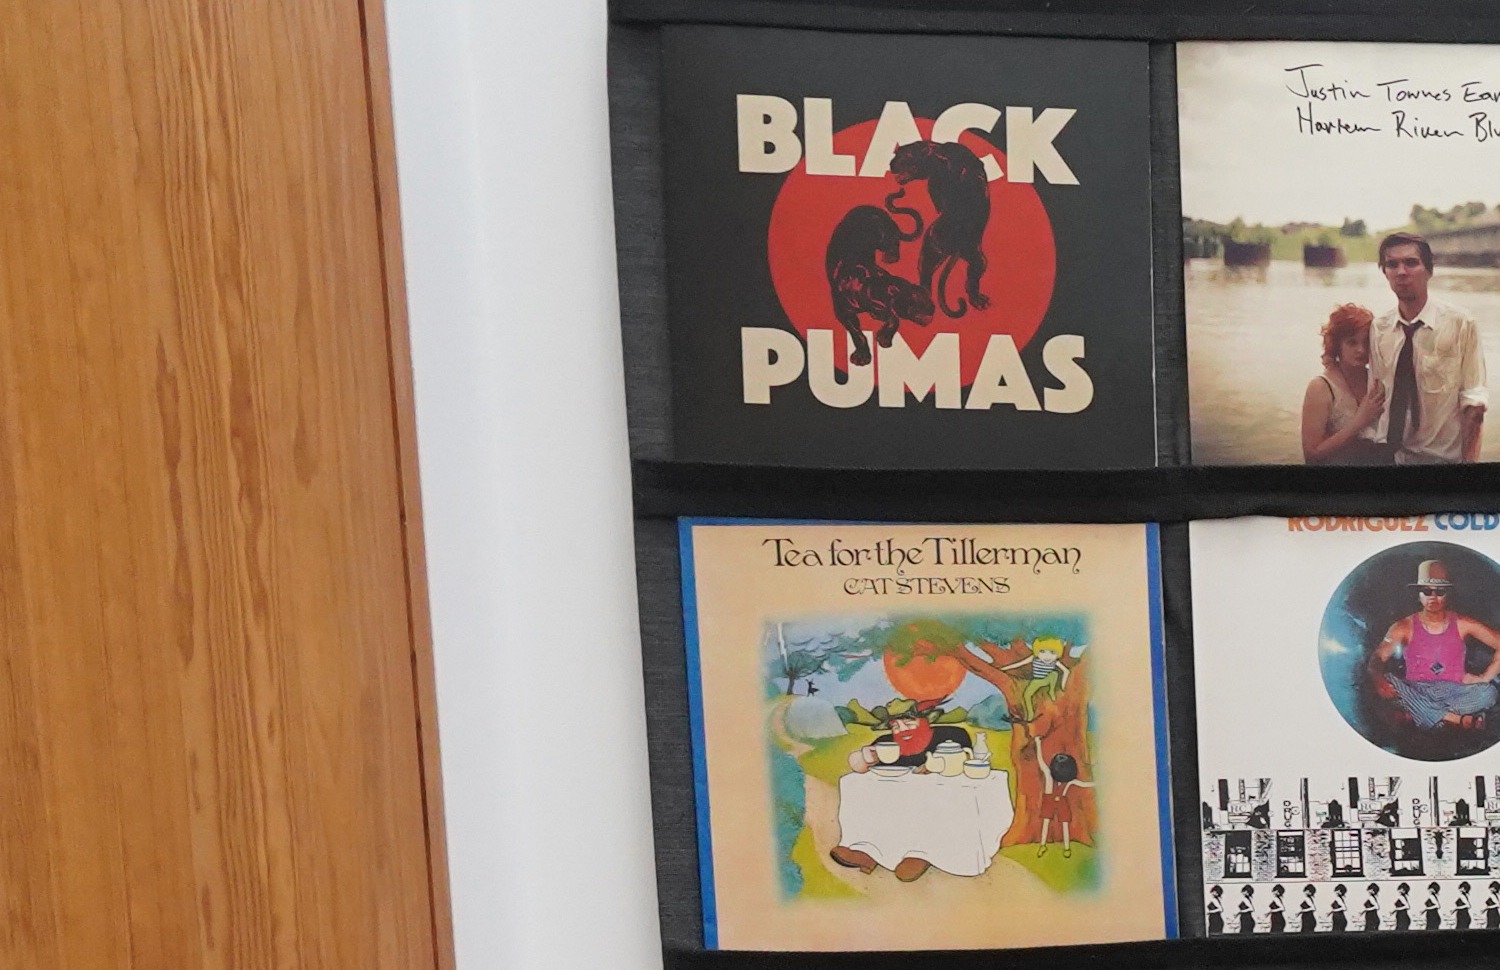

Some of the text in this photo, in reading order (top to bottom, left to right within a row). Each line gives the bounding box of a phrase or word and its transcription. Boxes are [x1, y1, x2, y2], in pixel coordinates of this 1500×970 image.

[1284, 64, 1371, 101] Justin
[1376, 79, 1452, 102] Townes
[736, 93, 1081, 186] BLACK
[741, 326, 1095, 414] PUMAS
[1288, 516, 1429, 532] RODRIGUEZ
[1434, 513, 1500, 531] COLD
[762, 537, 1082, 575] Tea for the Tillerman
[843, 577, 1011, 595] CAT STEVENS
